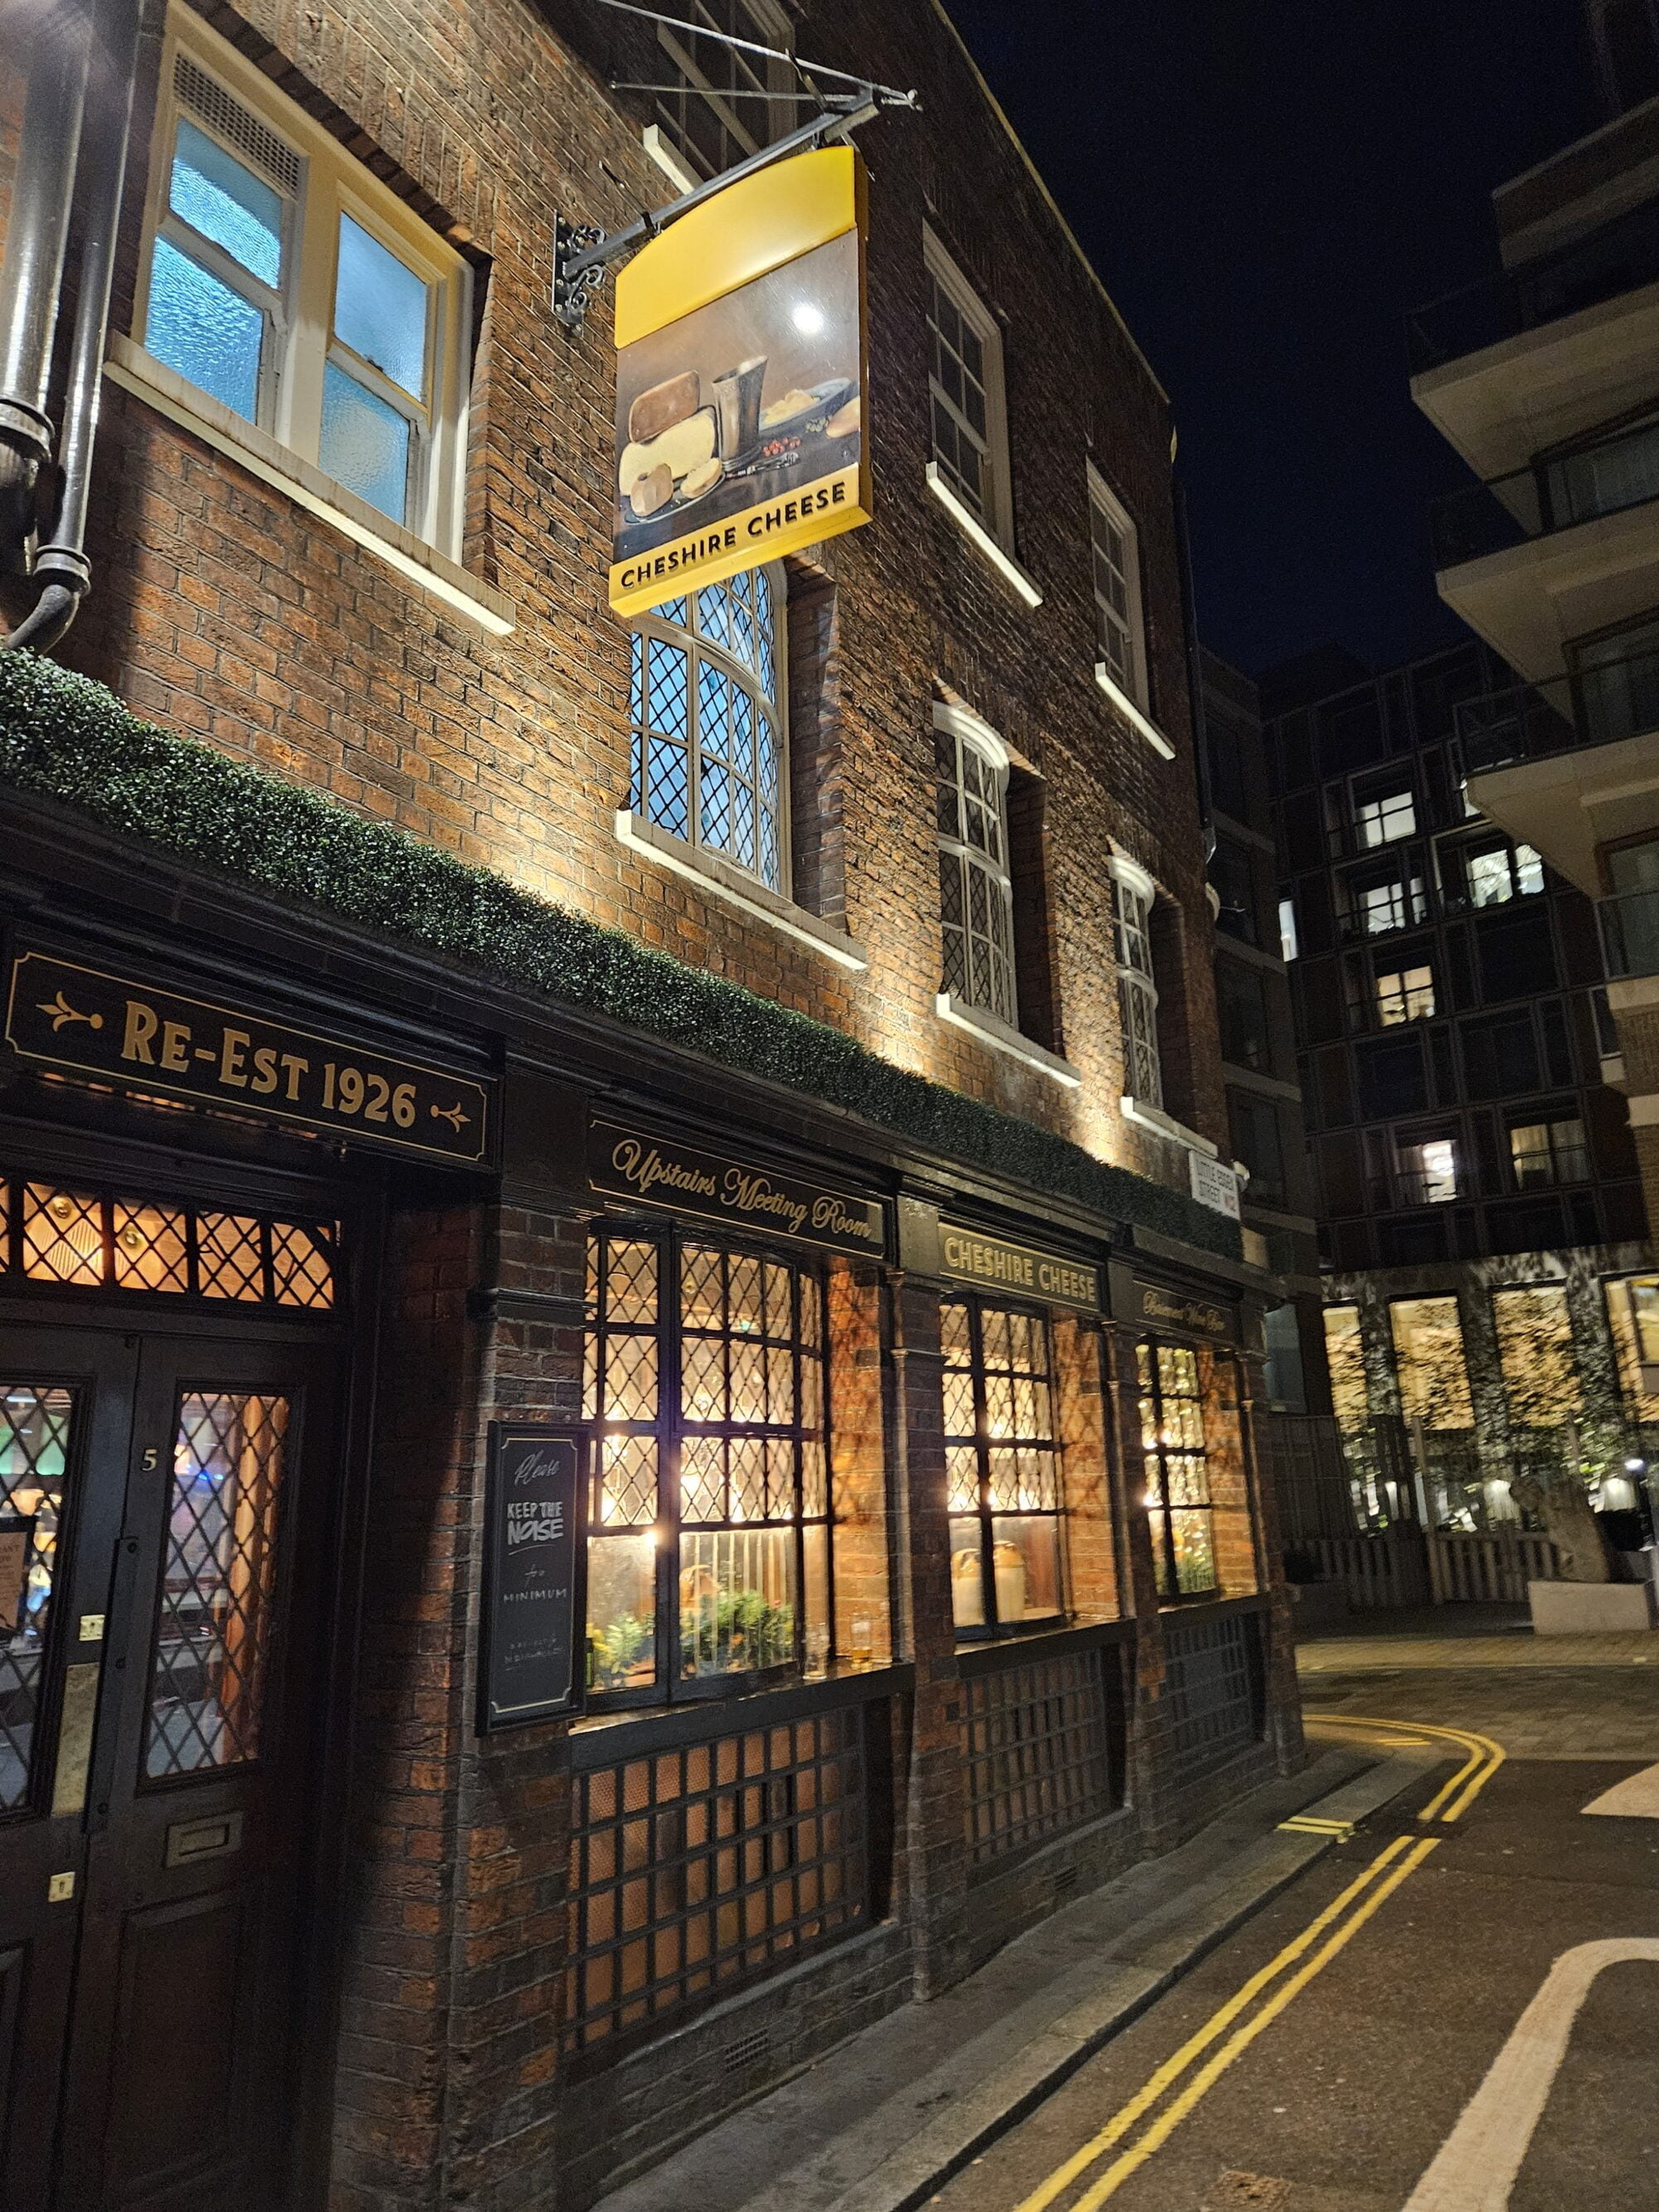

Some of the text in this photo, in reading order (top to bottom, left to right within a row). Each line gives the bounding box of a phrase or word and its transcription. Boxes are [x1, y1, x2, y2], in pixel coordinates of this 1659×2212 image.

[620, 481, 846, 588] CHESHIRE CHEESE
[321, 1062, 416, 1128] 1926
[612, 1139, 872, 1238] Upstairs Meeting Room
[944, 1237, 1096, 1301] CHESHIRE CHEESE
[140, 1448, 158, 1471] 5
[507, 1501, 562, 1519] KEEP THE
[508, 1518, 564, 1545] NOISE
[504, 1587, 567, 1602] MINIMUM
